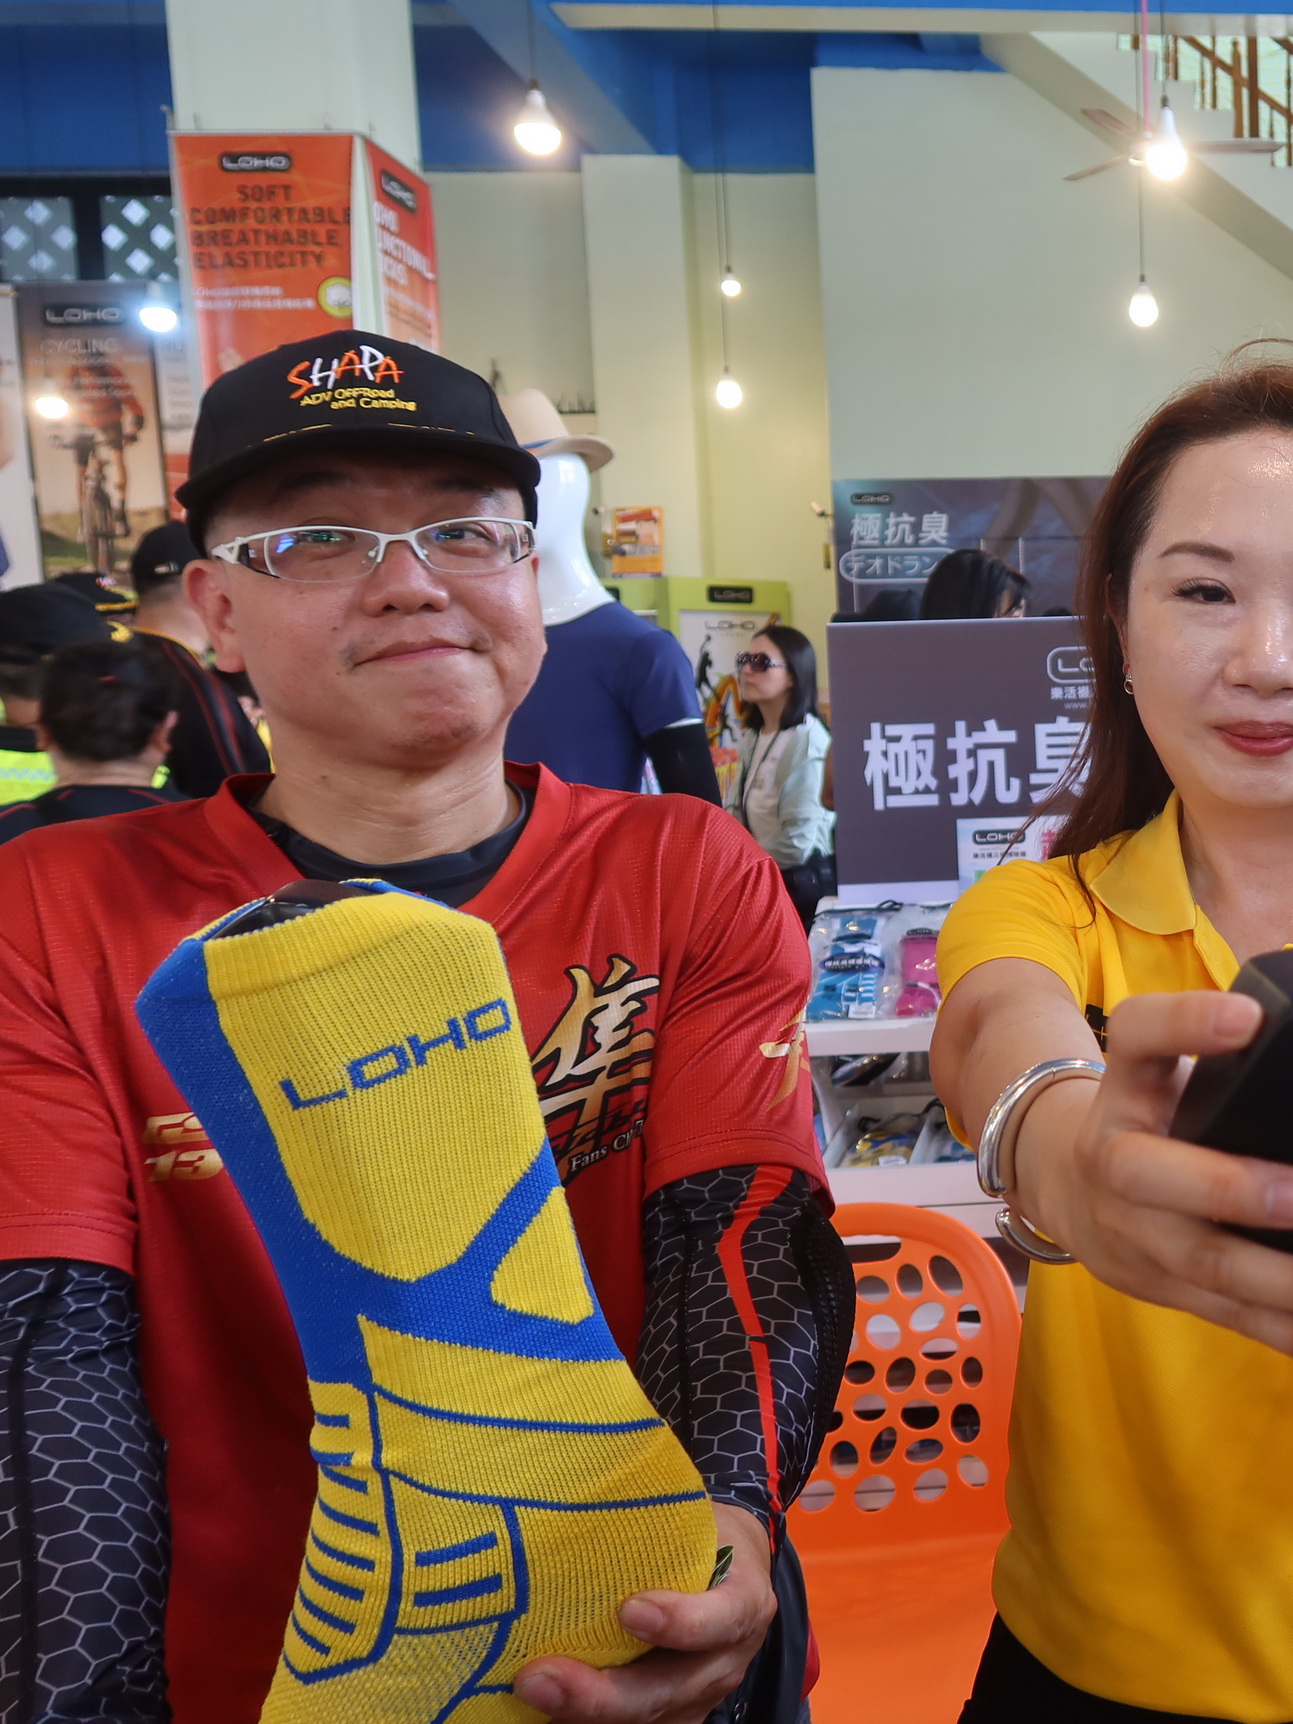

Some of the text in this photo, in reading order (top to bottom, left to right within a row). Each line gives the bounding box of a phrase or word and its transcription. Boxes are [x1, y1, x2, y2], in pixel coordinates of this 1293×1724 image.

[222, 156, 288, 169] LOHO
[236, 184, 293, 202] SOFT
[191, 229, 340, 247] BREATHABLE
[194, 252, 324, 269] ELASTICITY
[45, 307, 119, 323] LOHO
[39, 337, 119, 352] CYCLING
[286, 345, 405, 399] SHAPA
[300, 391, 332, 406] ADV
[330, 397, 417, 411] and Camping
[850, 511, 949, 545] 極抗臭
[846, 555, 938, 576] デオドラン
[705, 620, 755, 630] LOHO
[1058, 657, 1095, 672] LO
[863, 715, 1094, 811] 極抗臭
[280, 999, 511, 1110] LOHO
[144, 1149, 224, 1182] 13
[571, 1146, 608, 1172] Fans
